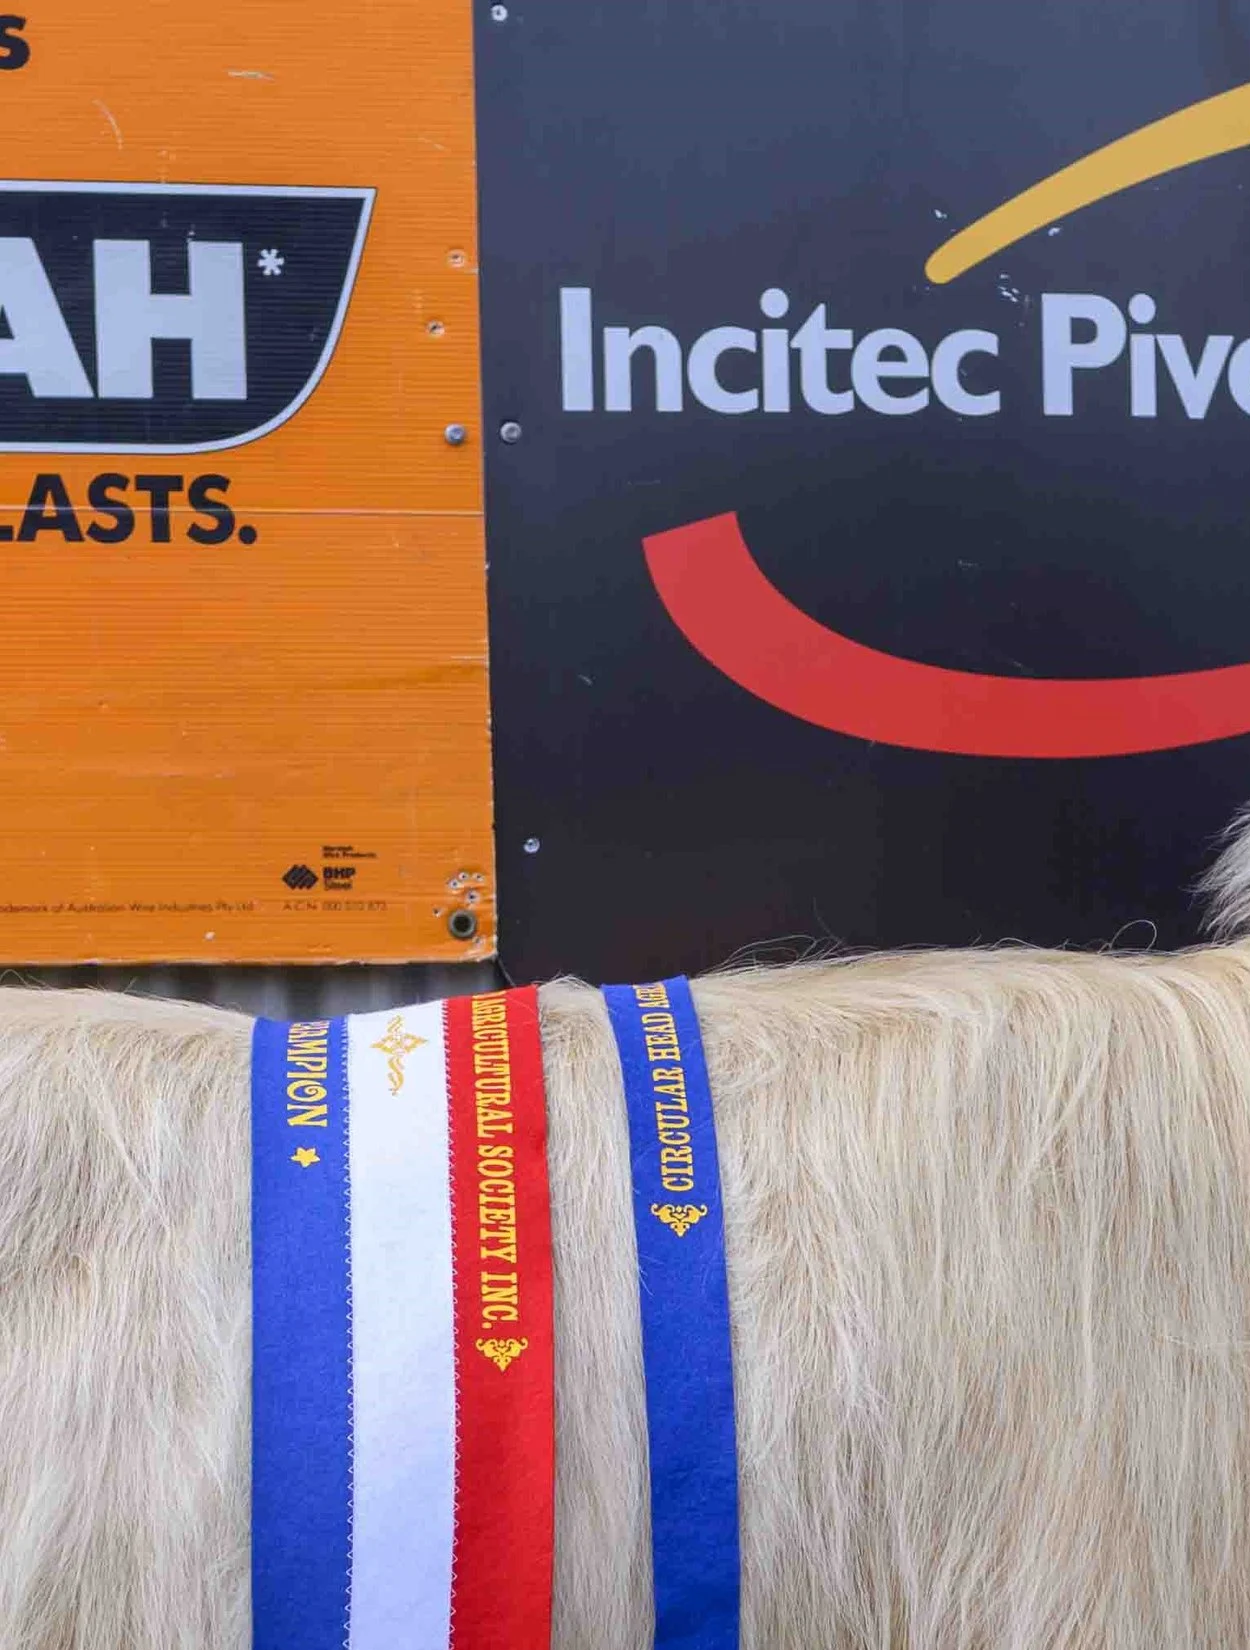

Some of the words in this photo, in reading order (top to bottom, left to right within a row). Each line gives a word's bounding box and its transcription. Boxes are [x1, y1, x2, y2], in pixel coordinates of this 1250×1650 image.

[560, 287, 1001, 416] Incitec
[0, 473, 258, 545] ASTS.
[323, 866, 357, 880] BHP
[470, 998, 514, 1138] AGRICULTURAL
[643, 1011, 680, 1063] HEAD
[652, 1067, 695, 1192] CIRCULAR
[477, 1143, 518, 1263] SOCIETY
[480, 1272, 519, 1330] INC.
